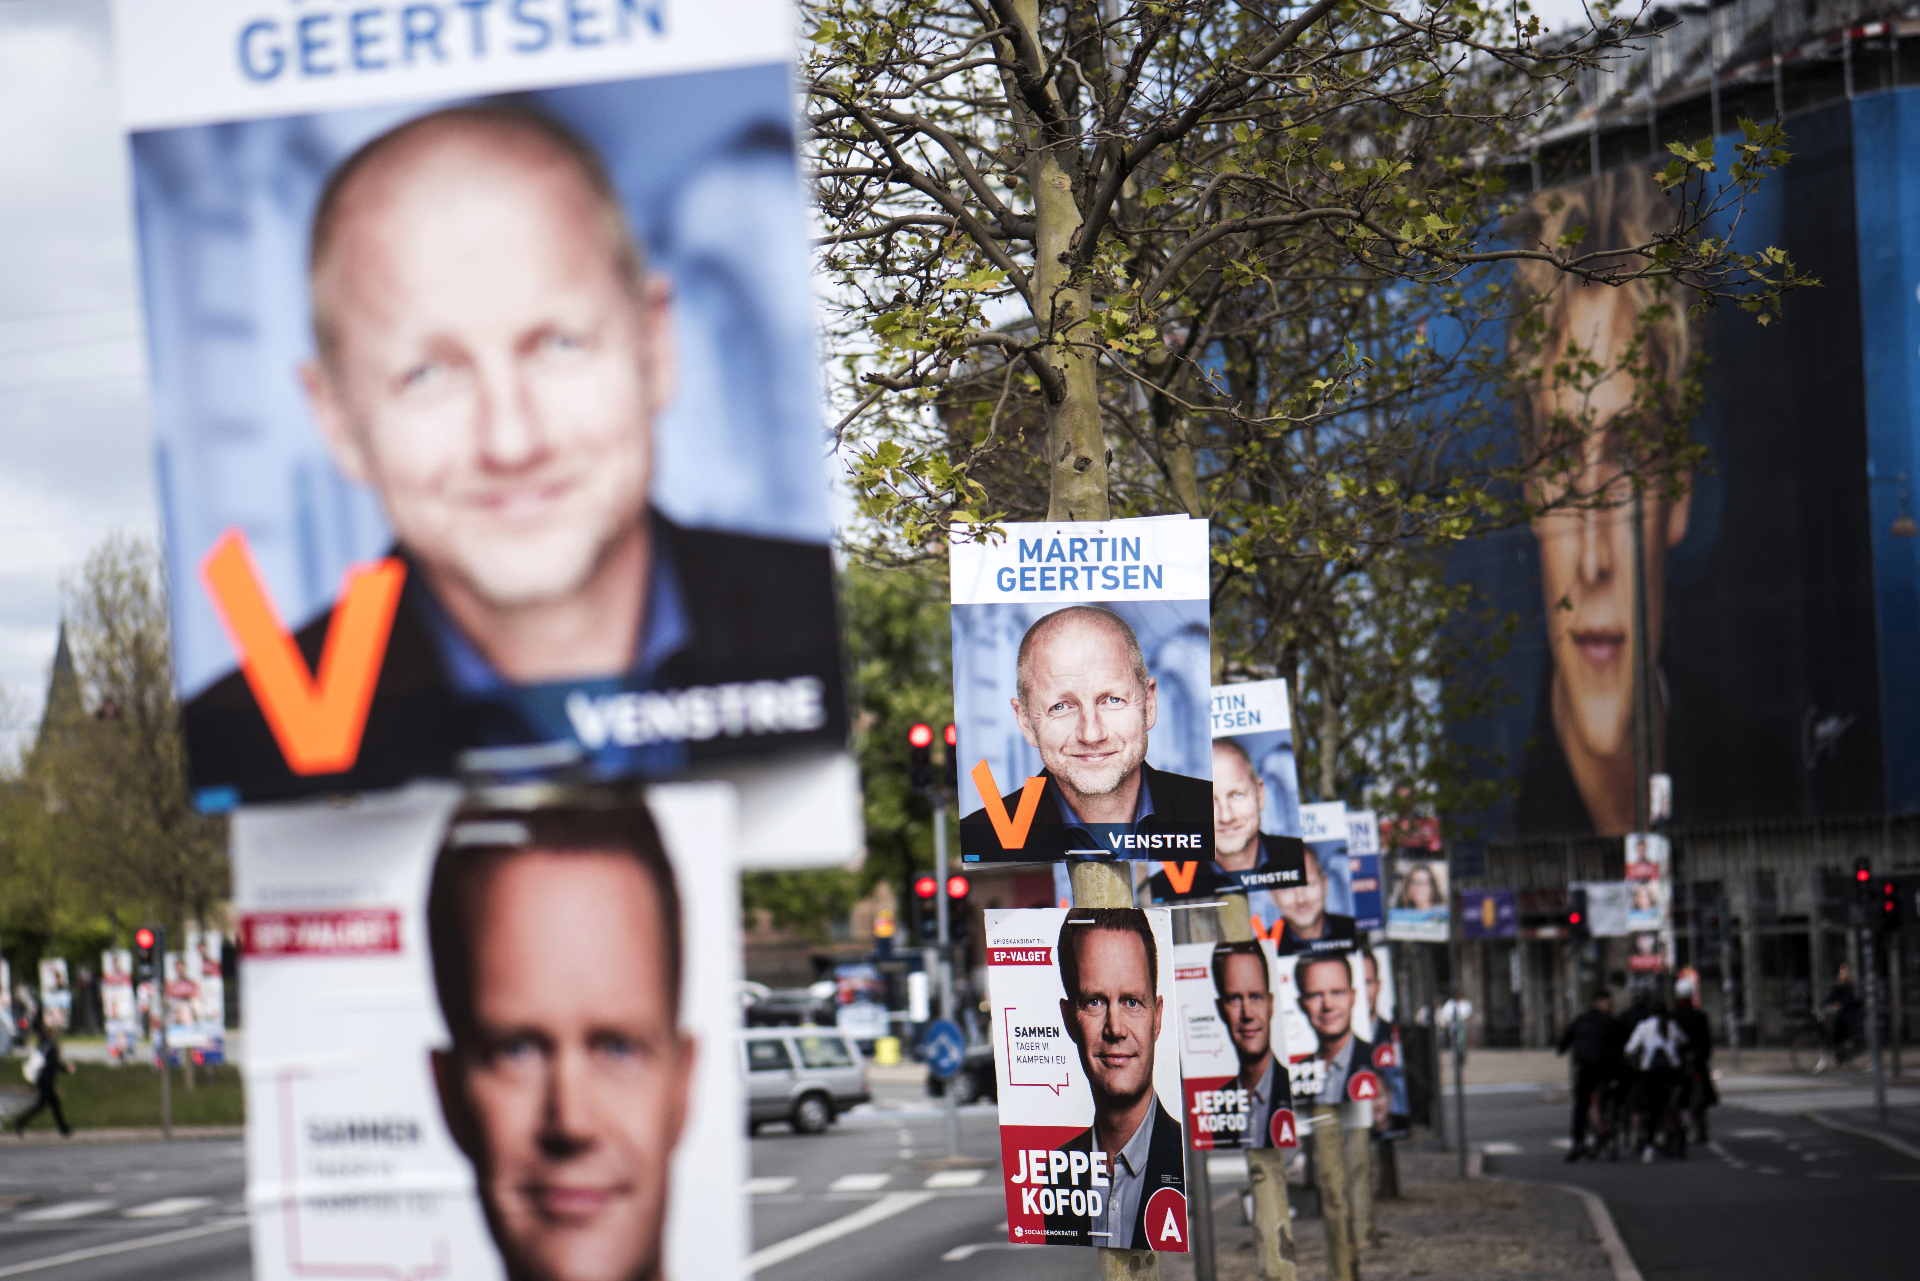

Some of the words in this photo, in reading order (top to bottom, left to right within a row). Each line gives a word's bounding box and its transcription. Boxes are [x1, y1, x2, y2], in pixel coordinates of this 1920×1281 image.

[237, 0, 667, 83] GEERTSEN
[1019, 537, 1141, 563] MARTIN
[997, 564, 1163, 592] GEERTSEN
[203, 525, 406, 775] V
[565, 676, 825, 749] VENSTRE
[970, 758, 1047, 849] V
[1108, 832, 1202, 849] VENSTRE
[1241, 870, 1299, 886] VENSTRE
[993, 951, 1047, 962] EP-VALGET
[1014, 1026, 1060, 1038] SAMMEN
[1016, 1042, 1041, 1051] TAGER
[1042, 1042, 1049, 1051] VI
[1016, 1055, 1050, 1065] KAMPEN
[1056, 1056, 1066, 1065] EU
[1357, 1077, 1375, 1097] A
[1191, 1088, 1250, 1114] JEPPE
[1197, 1113, 1248, 1133] KOFOD
[1279, 1120, 1295, 1142] A
[1010, 1149, 1110, 1187] JEPPE
[1021, 1187, 1103, 1217] KOFOD
[1024, 1229, 1078, 1237] SOCIALDEMOKRATIET
[1160, 1206, 1183, 1243] A
